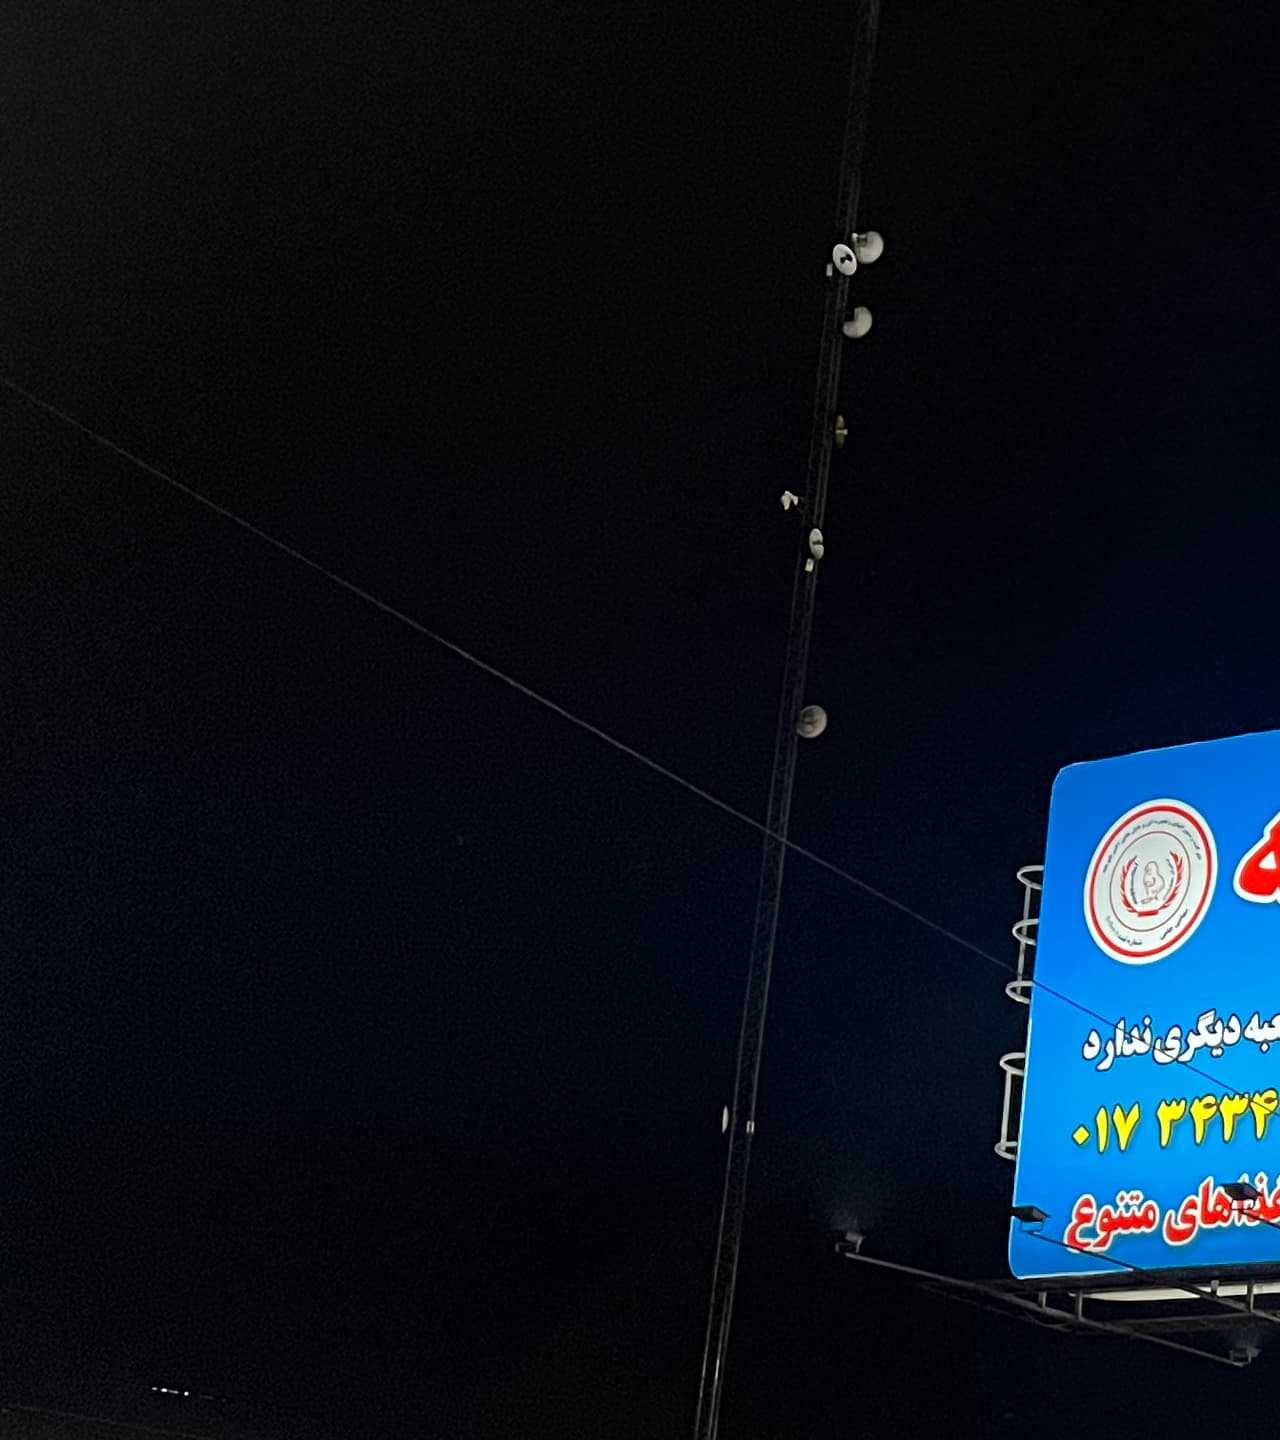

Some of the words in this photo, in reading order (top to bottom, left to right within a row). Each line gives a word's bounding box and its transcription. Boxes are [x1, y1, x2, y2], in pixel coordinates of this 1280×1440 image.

[1082, 1016, 1152, 1071] ندارد
[1152, 1009, 1241, 1065] دیگری
[1072, 1101, 1141, 1153] ۰۱۷
[1155, 1088, 1279, 1148] ۳۴۳۴
[1064, 1191, 1159, 1252] متنوع
